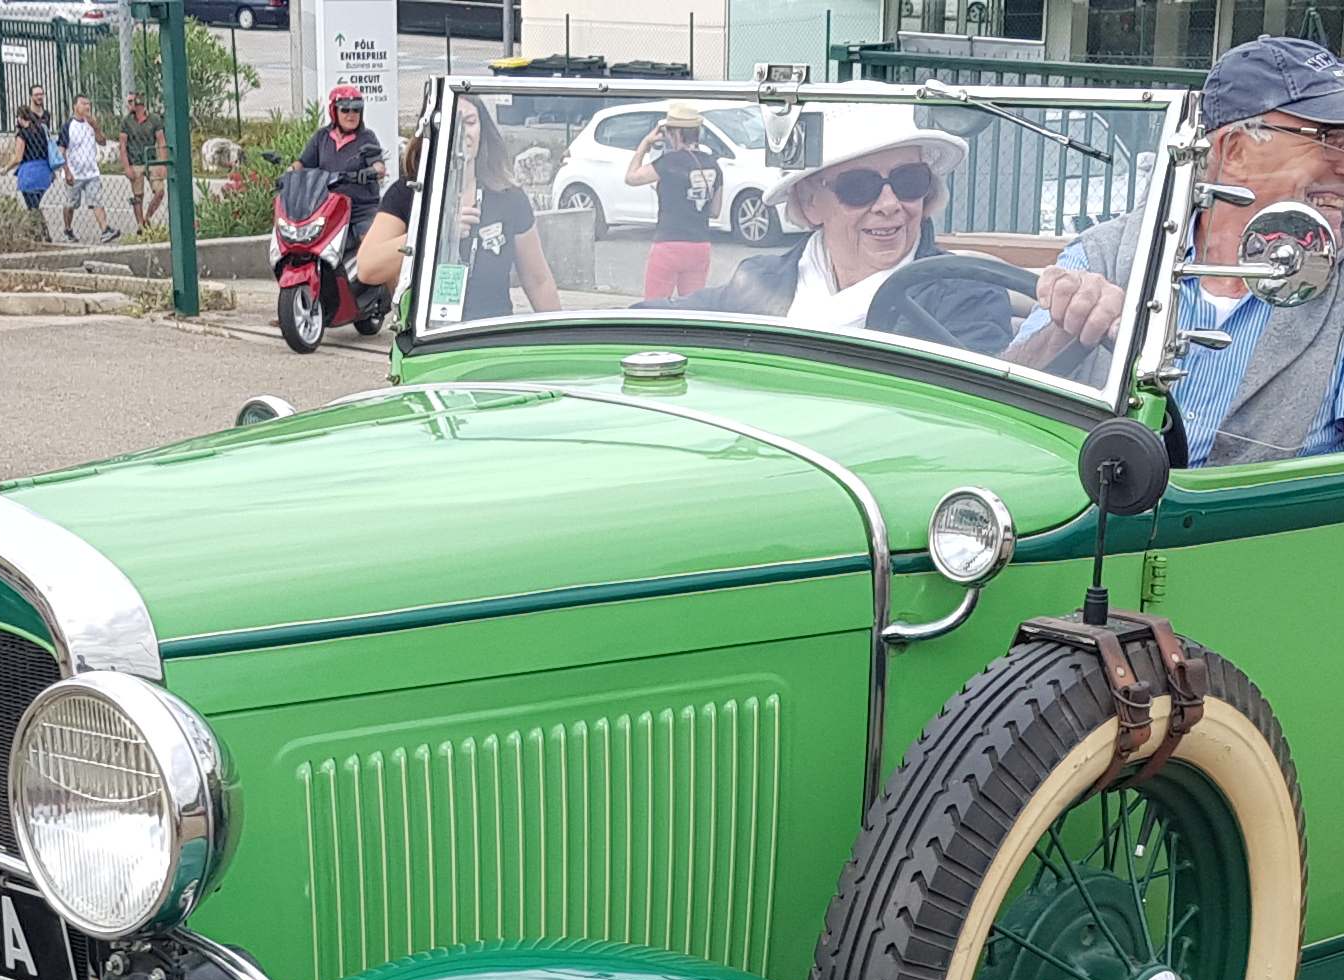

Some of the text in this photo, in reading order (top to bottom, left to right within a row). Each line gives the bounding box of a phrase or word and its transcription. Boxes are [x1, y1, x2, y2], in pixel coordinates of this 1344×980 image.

[354, 39, 375, 50] PÔLE
[340, 51, 387, 60] ENTREPRISE
[350, 75, 381, 84] CIRCUIT
